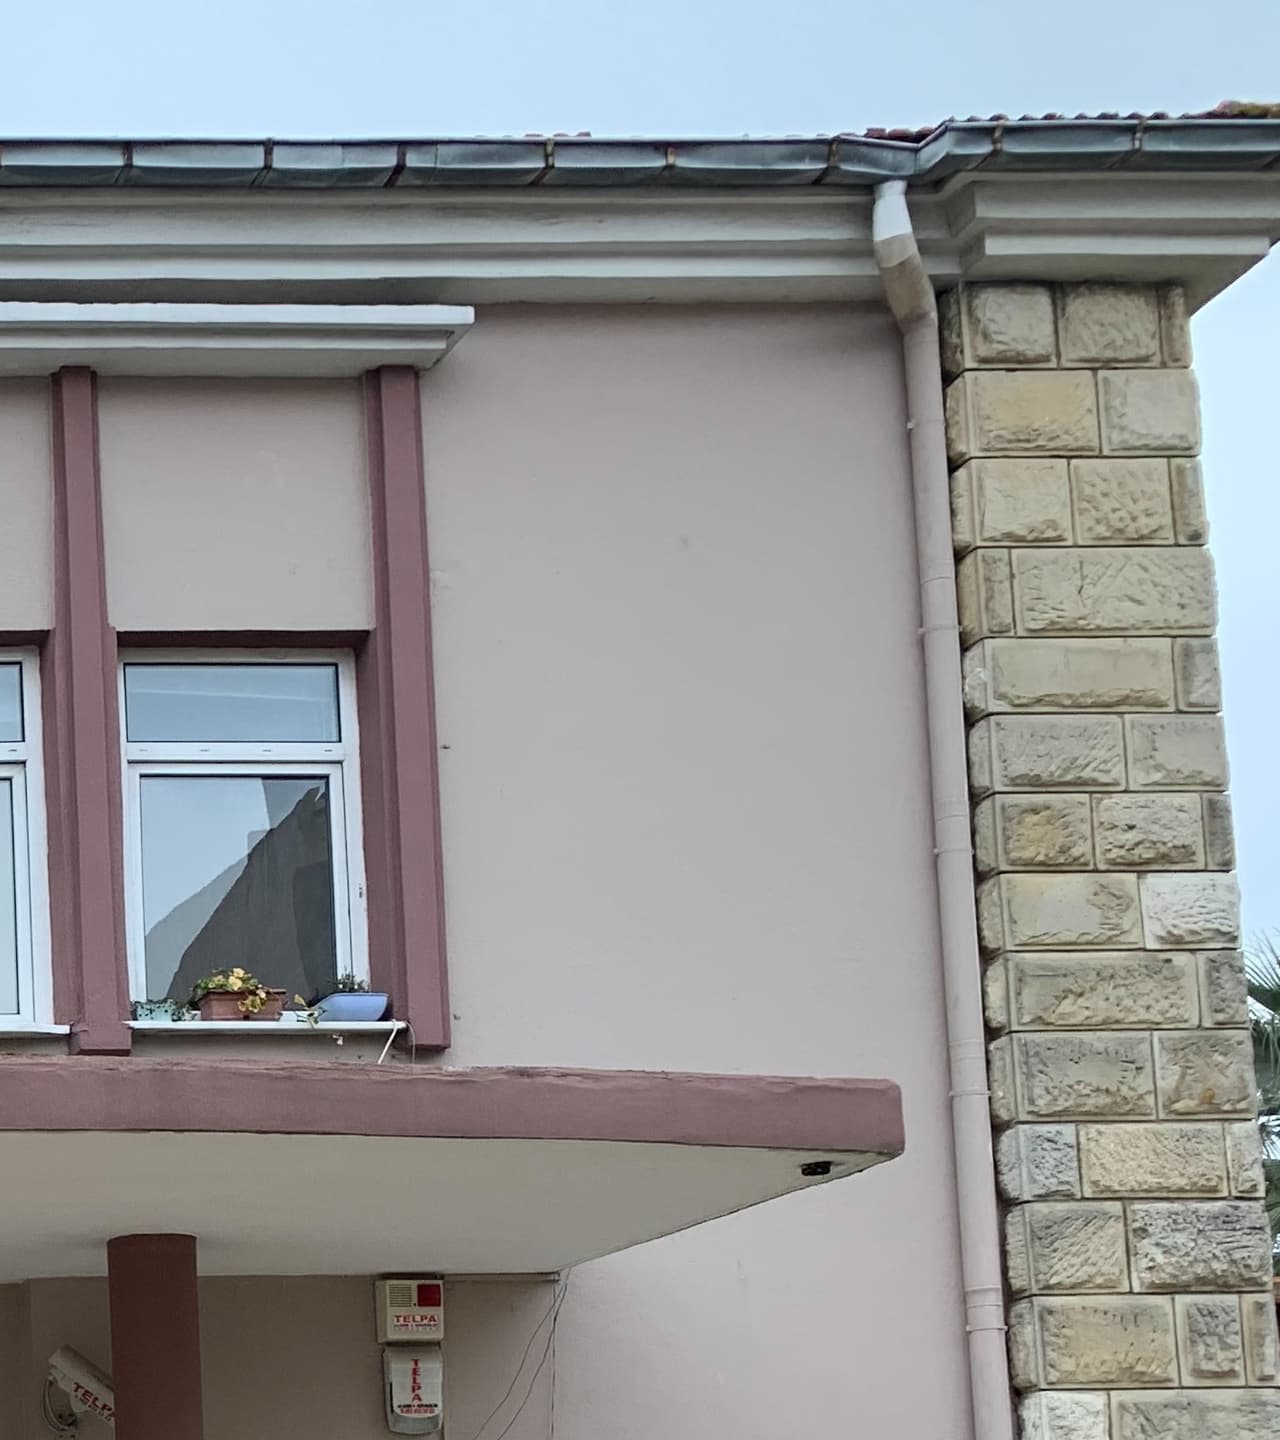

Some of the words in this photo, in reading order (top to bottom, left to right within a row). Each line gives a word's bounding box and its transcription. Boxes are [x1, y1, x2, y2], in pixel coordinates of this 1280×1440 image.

[394, 1314, 437, 1323] TELPA
[410, 1358, 423, 1402] TELPA
[72, 1382, 115, 1418] TELP
